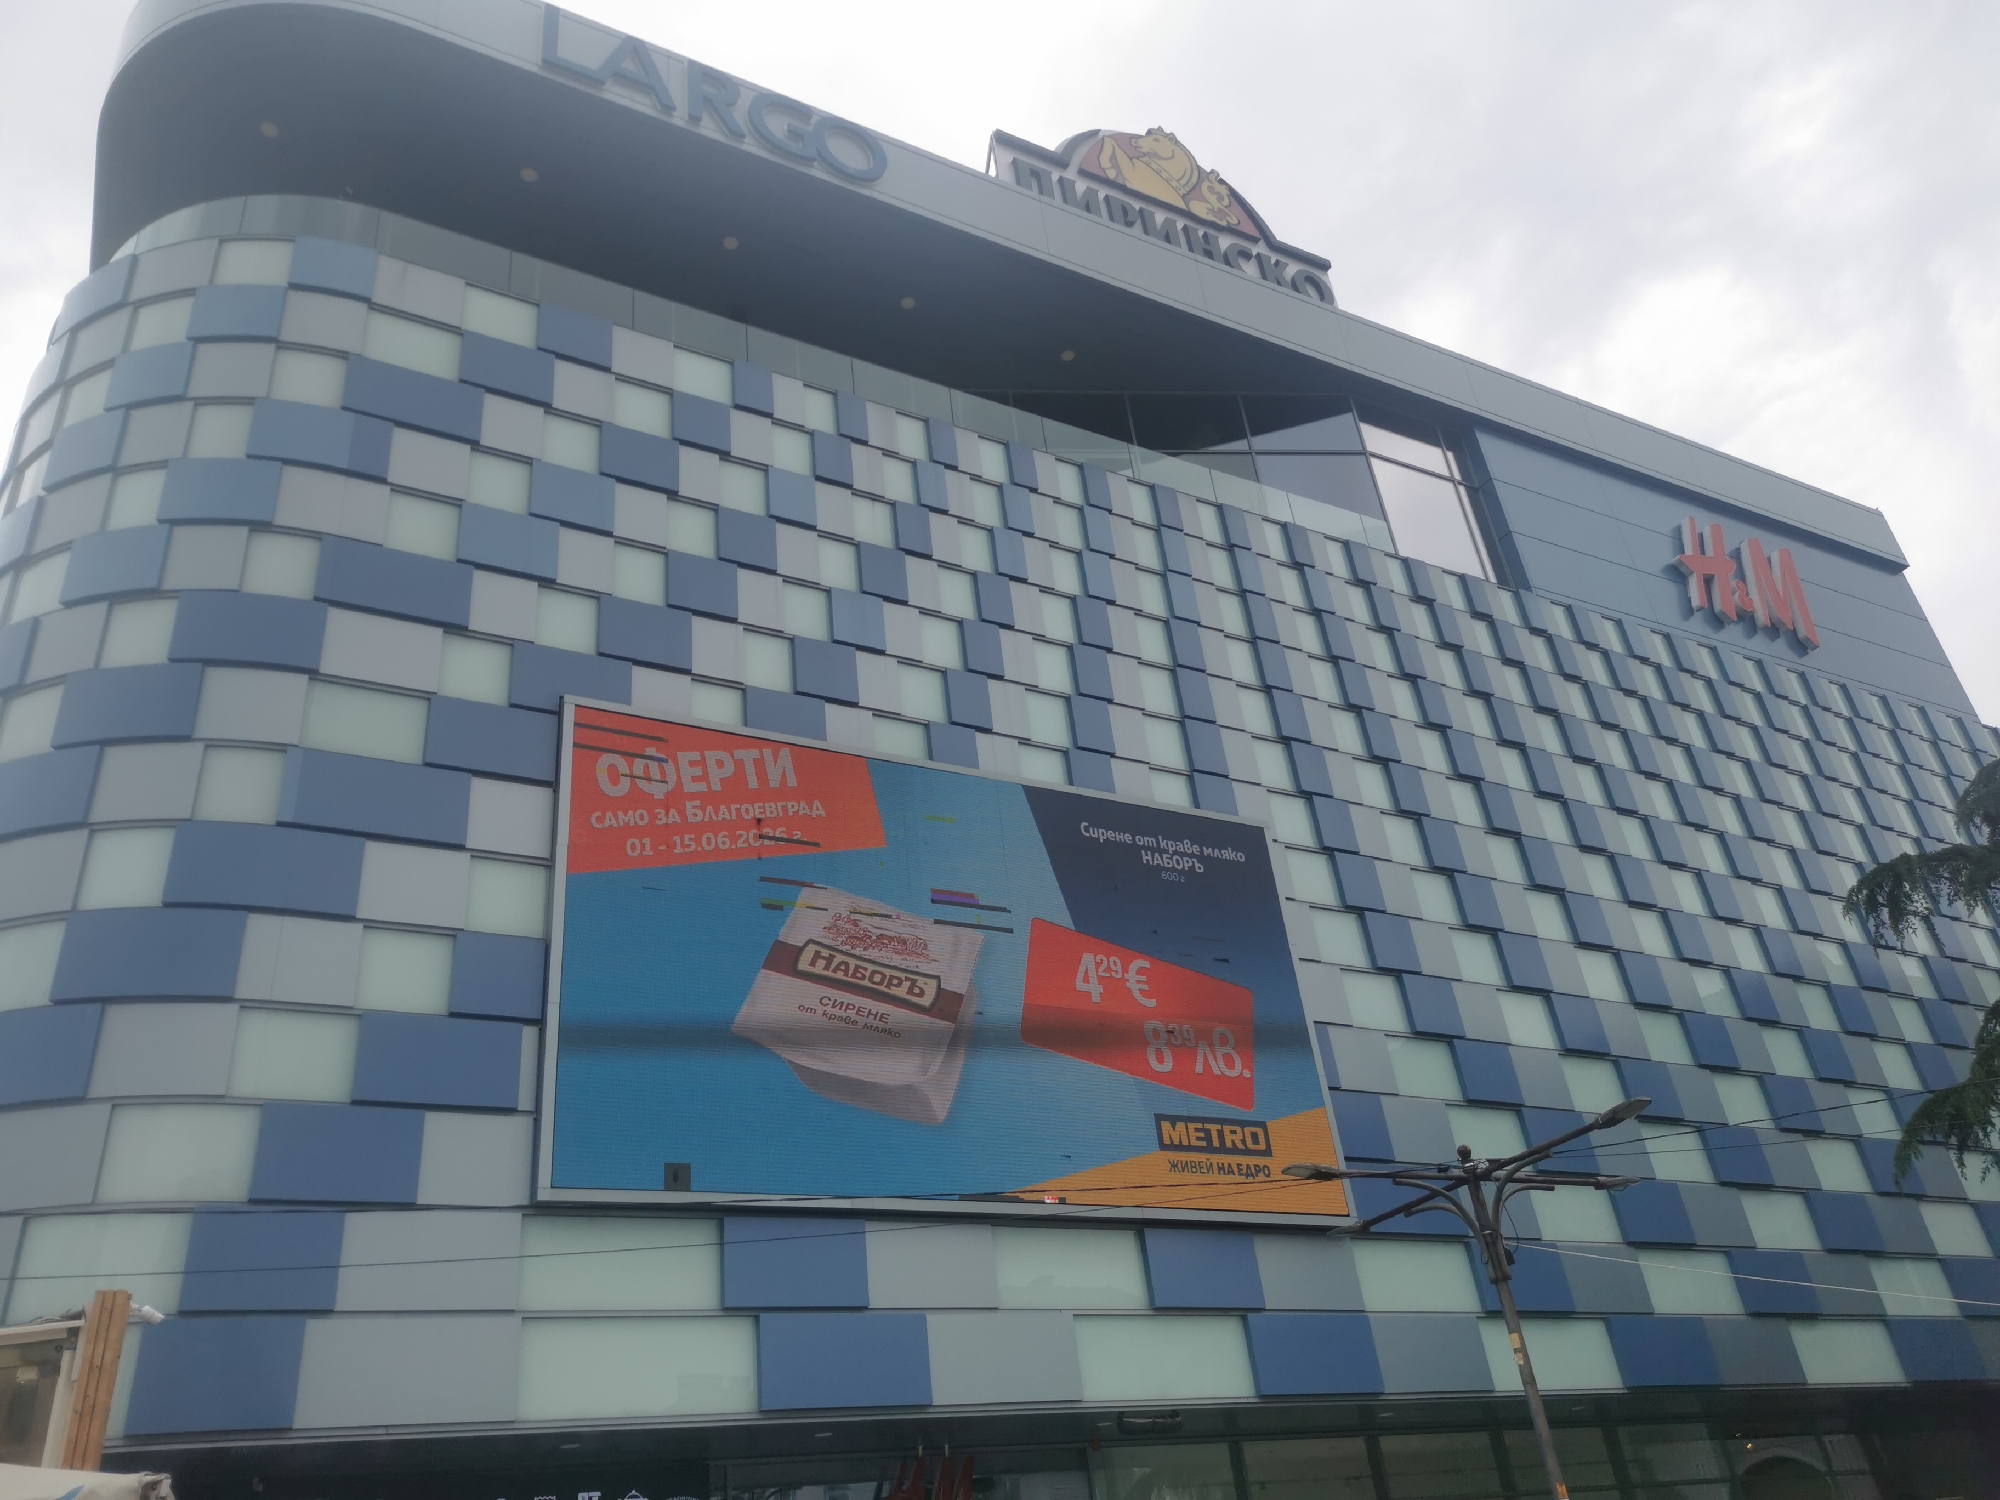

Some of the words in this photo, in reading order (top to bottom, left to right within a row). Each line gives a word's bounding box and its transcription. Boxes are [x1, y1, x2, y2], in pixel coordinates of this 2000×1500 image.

[541, 4, 888, 184] LARGO
[1010, 156, 1334, 307] ПИРИНСКО
[1674, 515, 1820, 651] H&M
[595, 747, 798, 799] ОФЕРТИ
[590, 809, 649, 829] САМО
[655, 806, 680, 825] ЗА
[625, 837, 653, 857] 01
[1080, 821, 1132, 844] Сирене
[1135, 834, 1157, 849] от
[1159, 835, 1200, 855] краве
[1203, 846, 1246, 862] мляко
[1141, 850, 1204, 873] НАБОРЪ
[1161, 870, 1178, 882] 600
[808, 949, 926, 999] НАБОРЪ
[797, 1002, 817, 1015] от
[821, 1008, 858, 1027] краве
[862, 1021, 902, 1039] мляко
[818, 995, 890, 1025] СИРЕНЕ
[1160, 1120, 1267, 1151] METRO
[1168, 1158, 1214, 1175] ЖИВЕЙ
